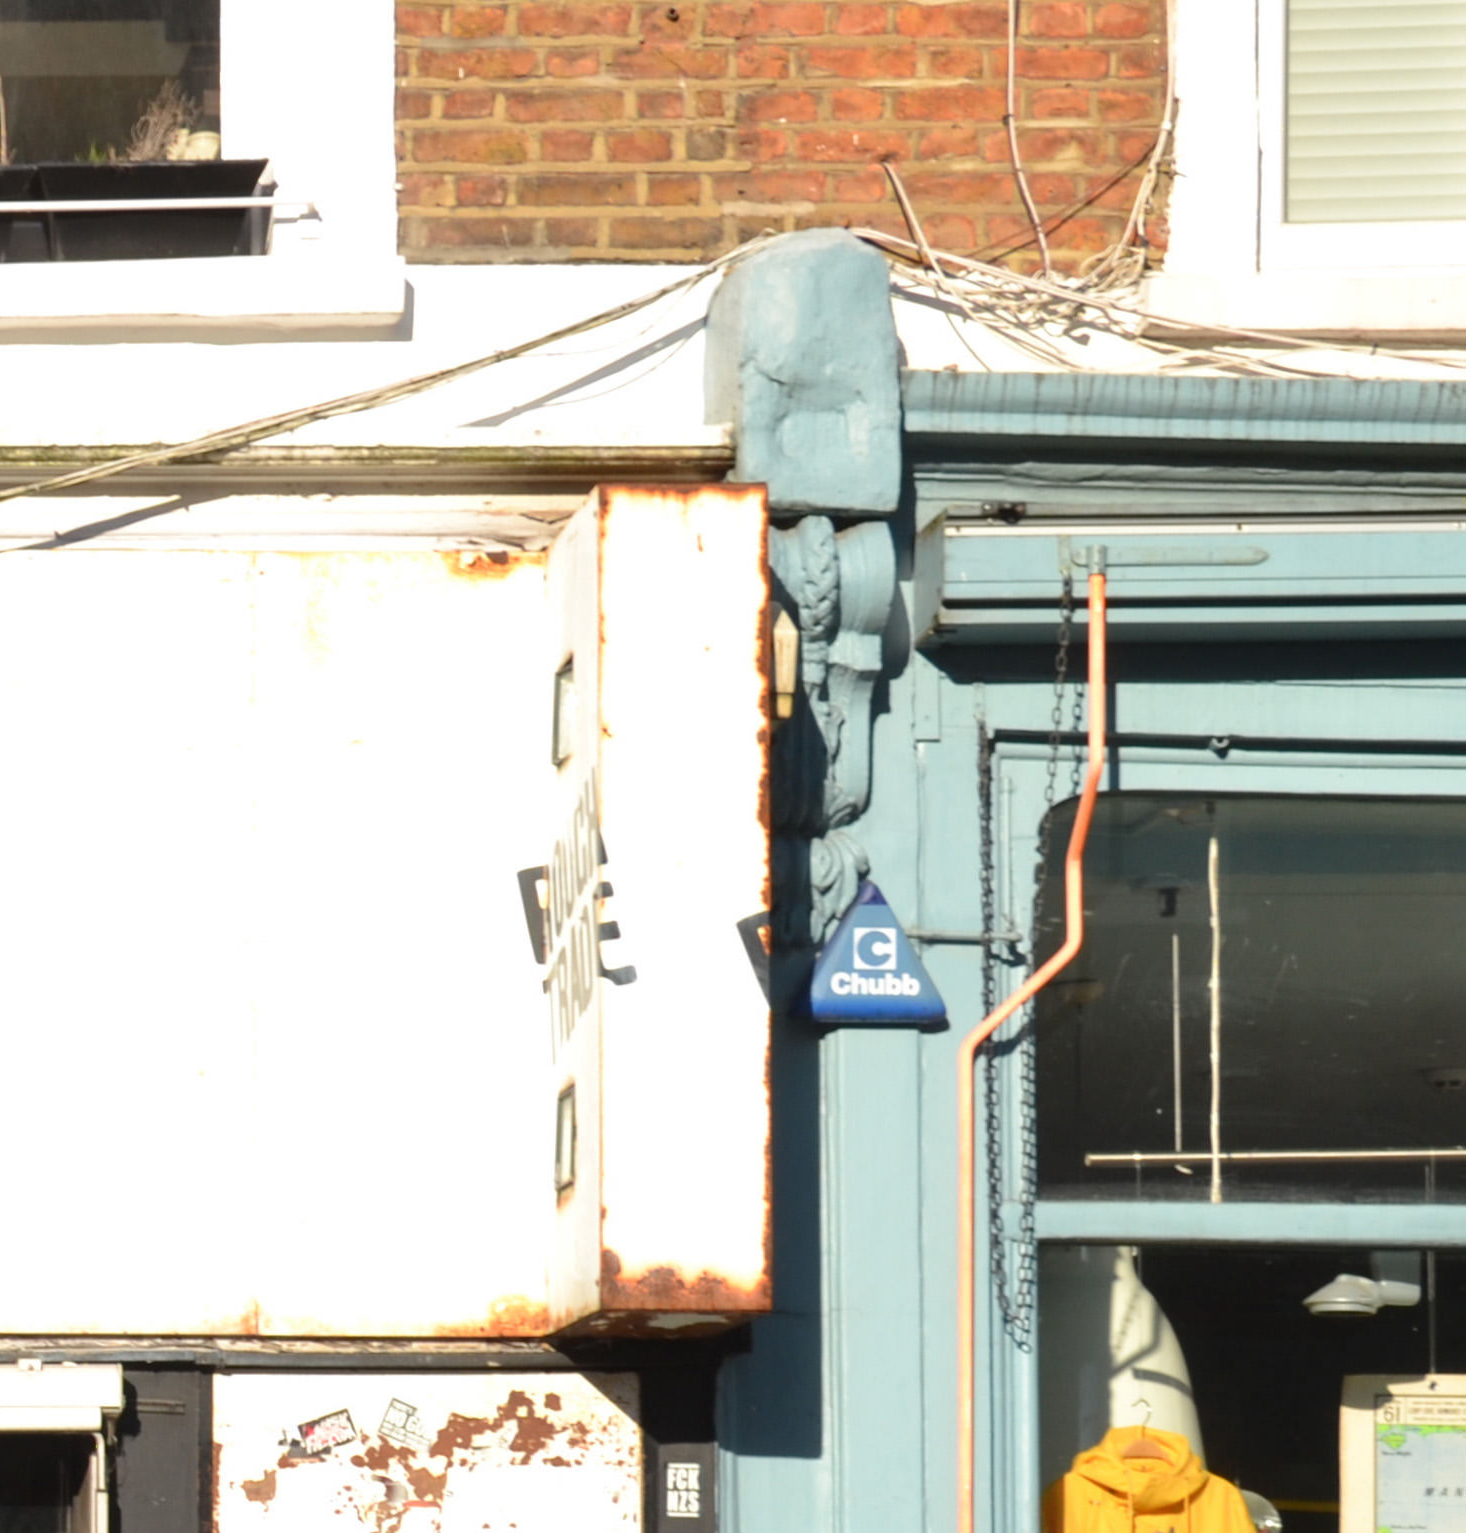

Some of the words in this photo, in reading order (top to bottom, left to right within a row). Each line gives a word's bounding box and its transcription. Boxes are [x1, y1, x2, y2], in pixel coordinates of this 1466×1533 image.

[829, 971, 921, 996] Chubb
[666, 1467, 700, 1491] FCK
[666, 1490, 700, 1513] NZS
